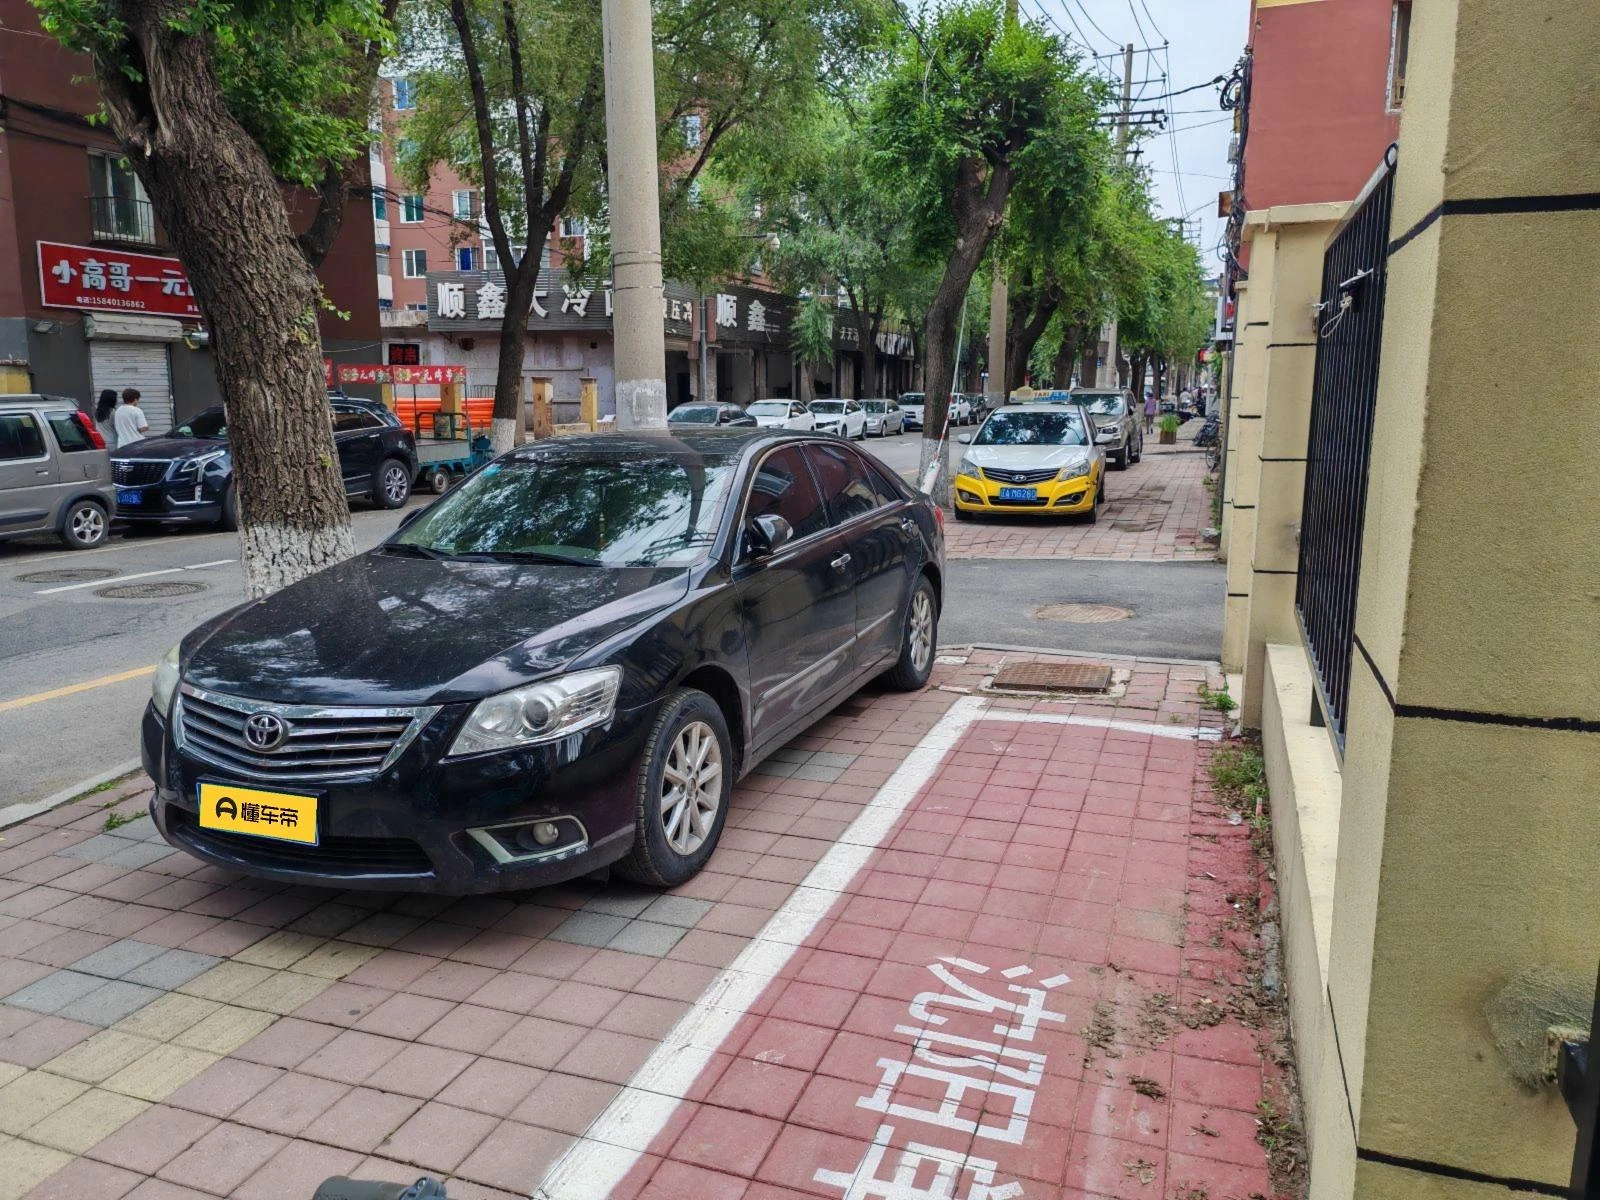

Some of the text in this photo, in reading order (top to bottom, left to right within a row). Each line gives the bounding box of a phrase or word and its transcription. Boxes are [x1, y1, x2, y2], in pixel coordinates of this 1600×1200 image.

[51, 258, 194, 297] 小高哥一元
